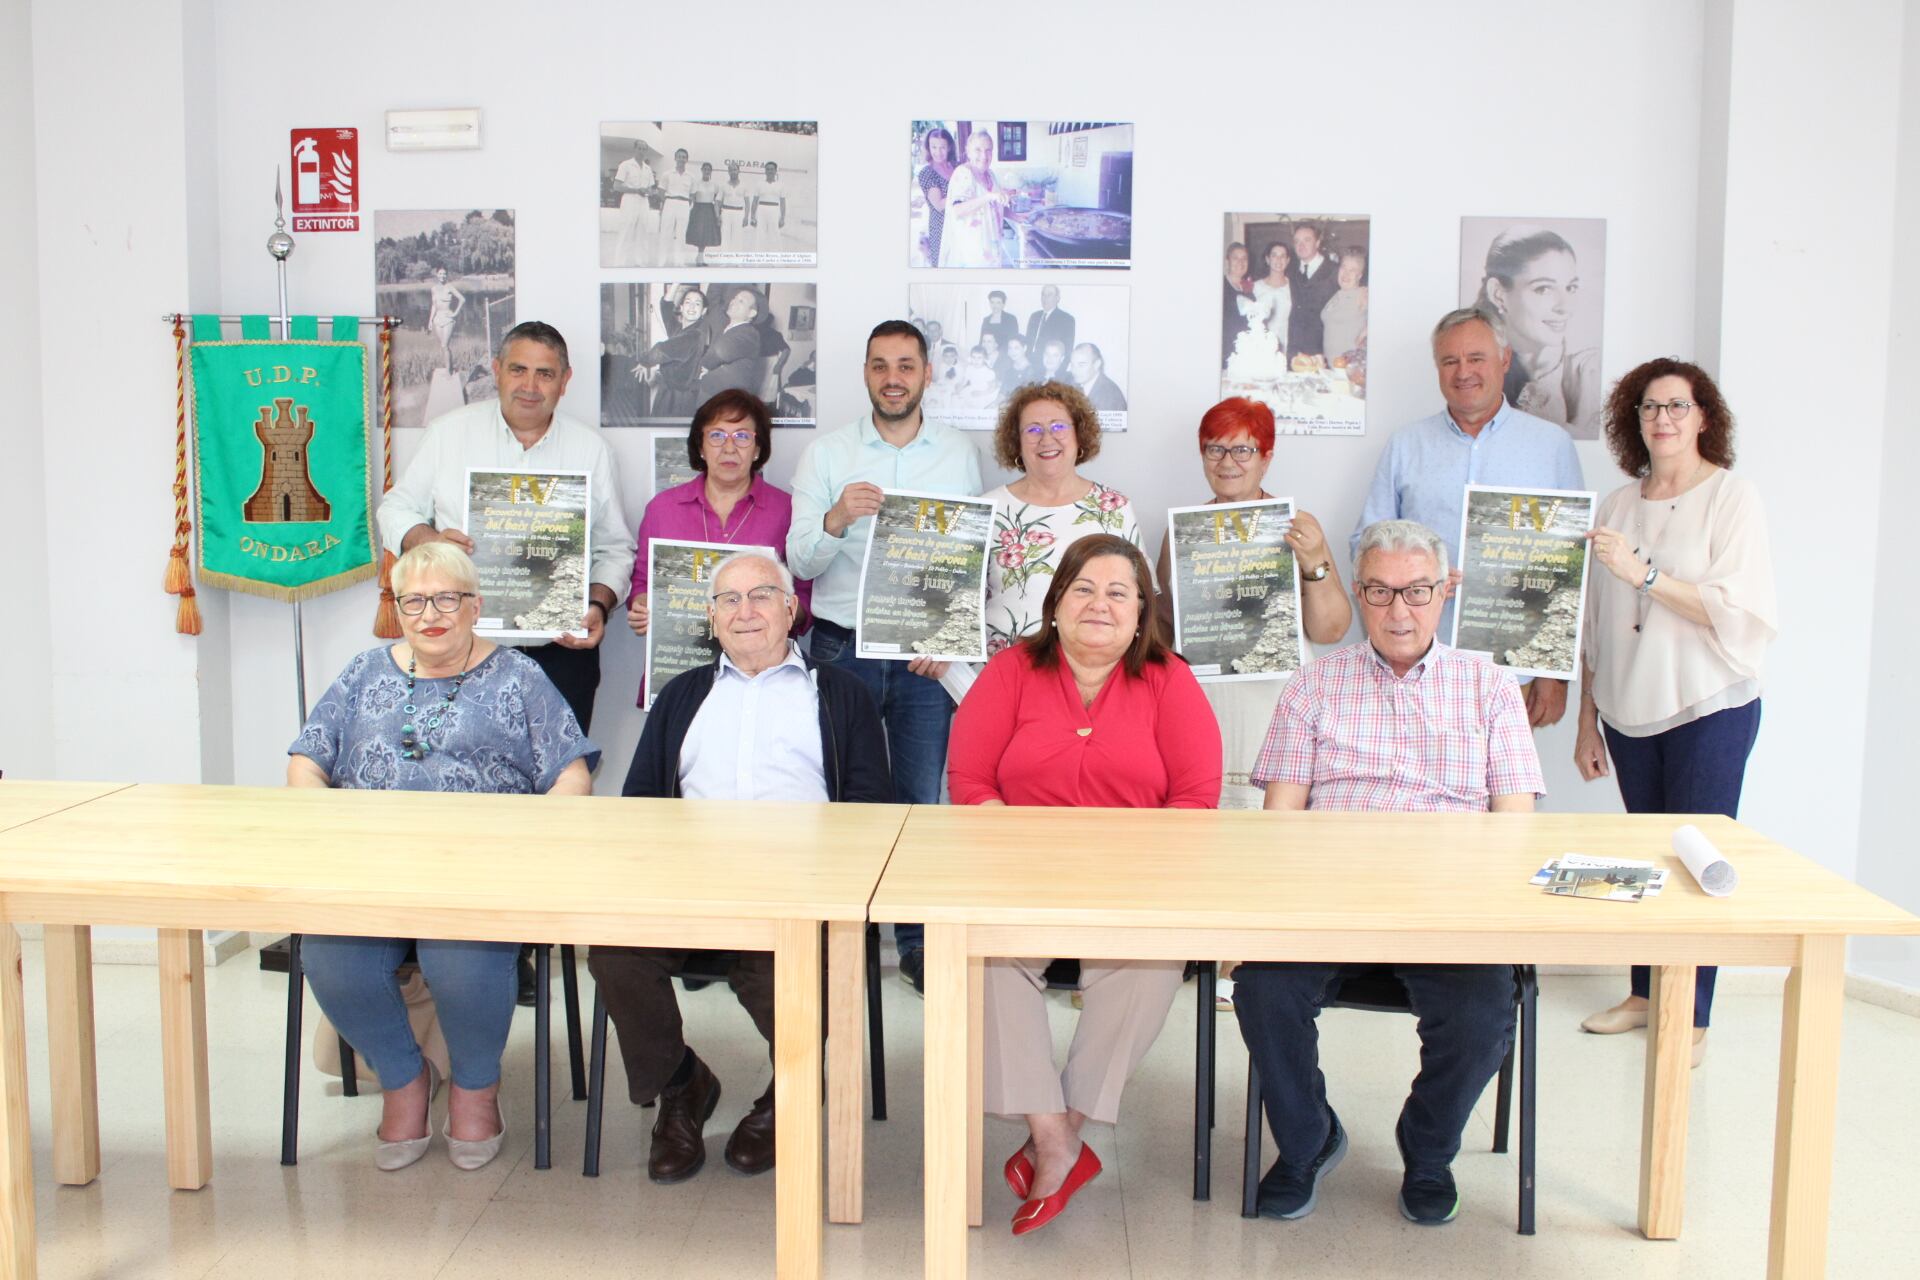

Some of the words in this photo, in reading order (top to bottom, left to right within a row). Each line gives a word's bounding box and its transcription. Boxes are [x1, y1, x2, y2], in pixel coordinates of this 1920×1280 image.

[296, 219, 355, 230] EXTINTOR
[243, 365, 321, 387] U.D.P.
[531, 520, 570, 533] Girona
[239, 533, 342, 562] ONDARA
[505, 543, 523, 556] de
[526, 543, 560, 560] juny
[930, 551, 968, 566] Girona
[1529, 549, 1569, 564] Girona
[1239, 560, 1278, 573] Girona
[901, 571, 920, 587] de
[922, 574, 956, 594] juny
[1502, 572, 1519, 588] de
[1521, 574, 1556, 593] juny
[1215, 584, 1233, 600] de
[1236, 584, 1268, 601] juny
[673, 620, 684, 636] 4
[687, 622, 705, 637] de
